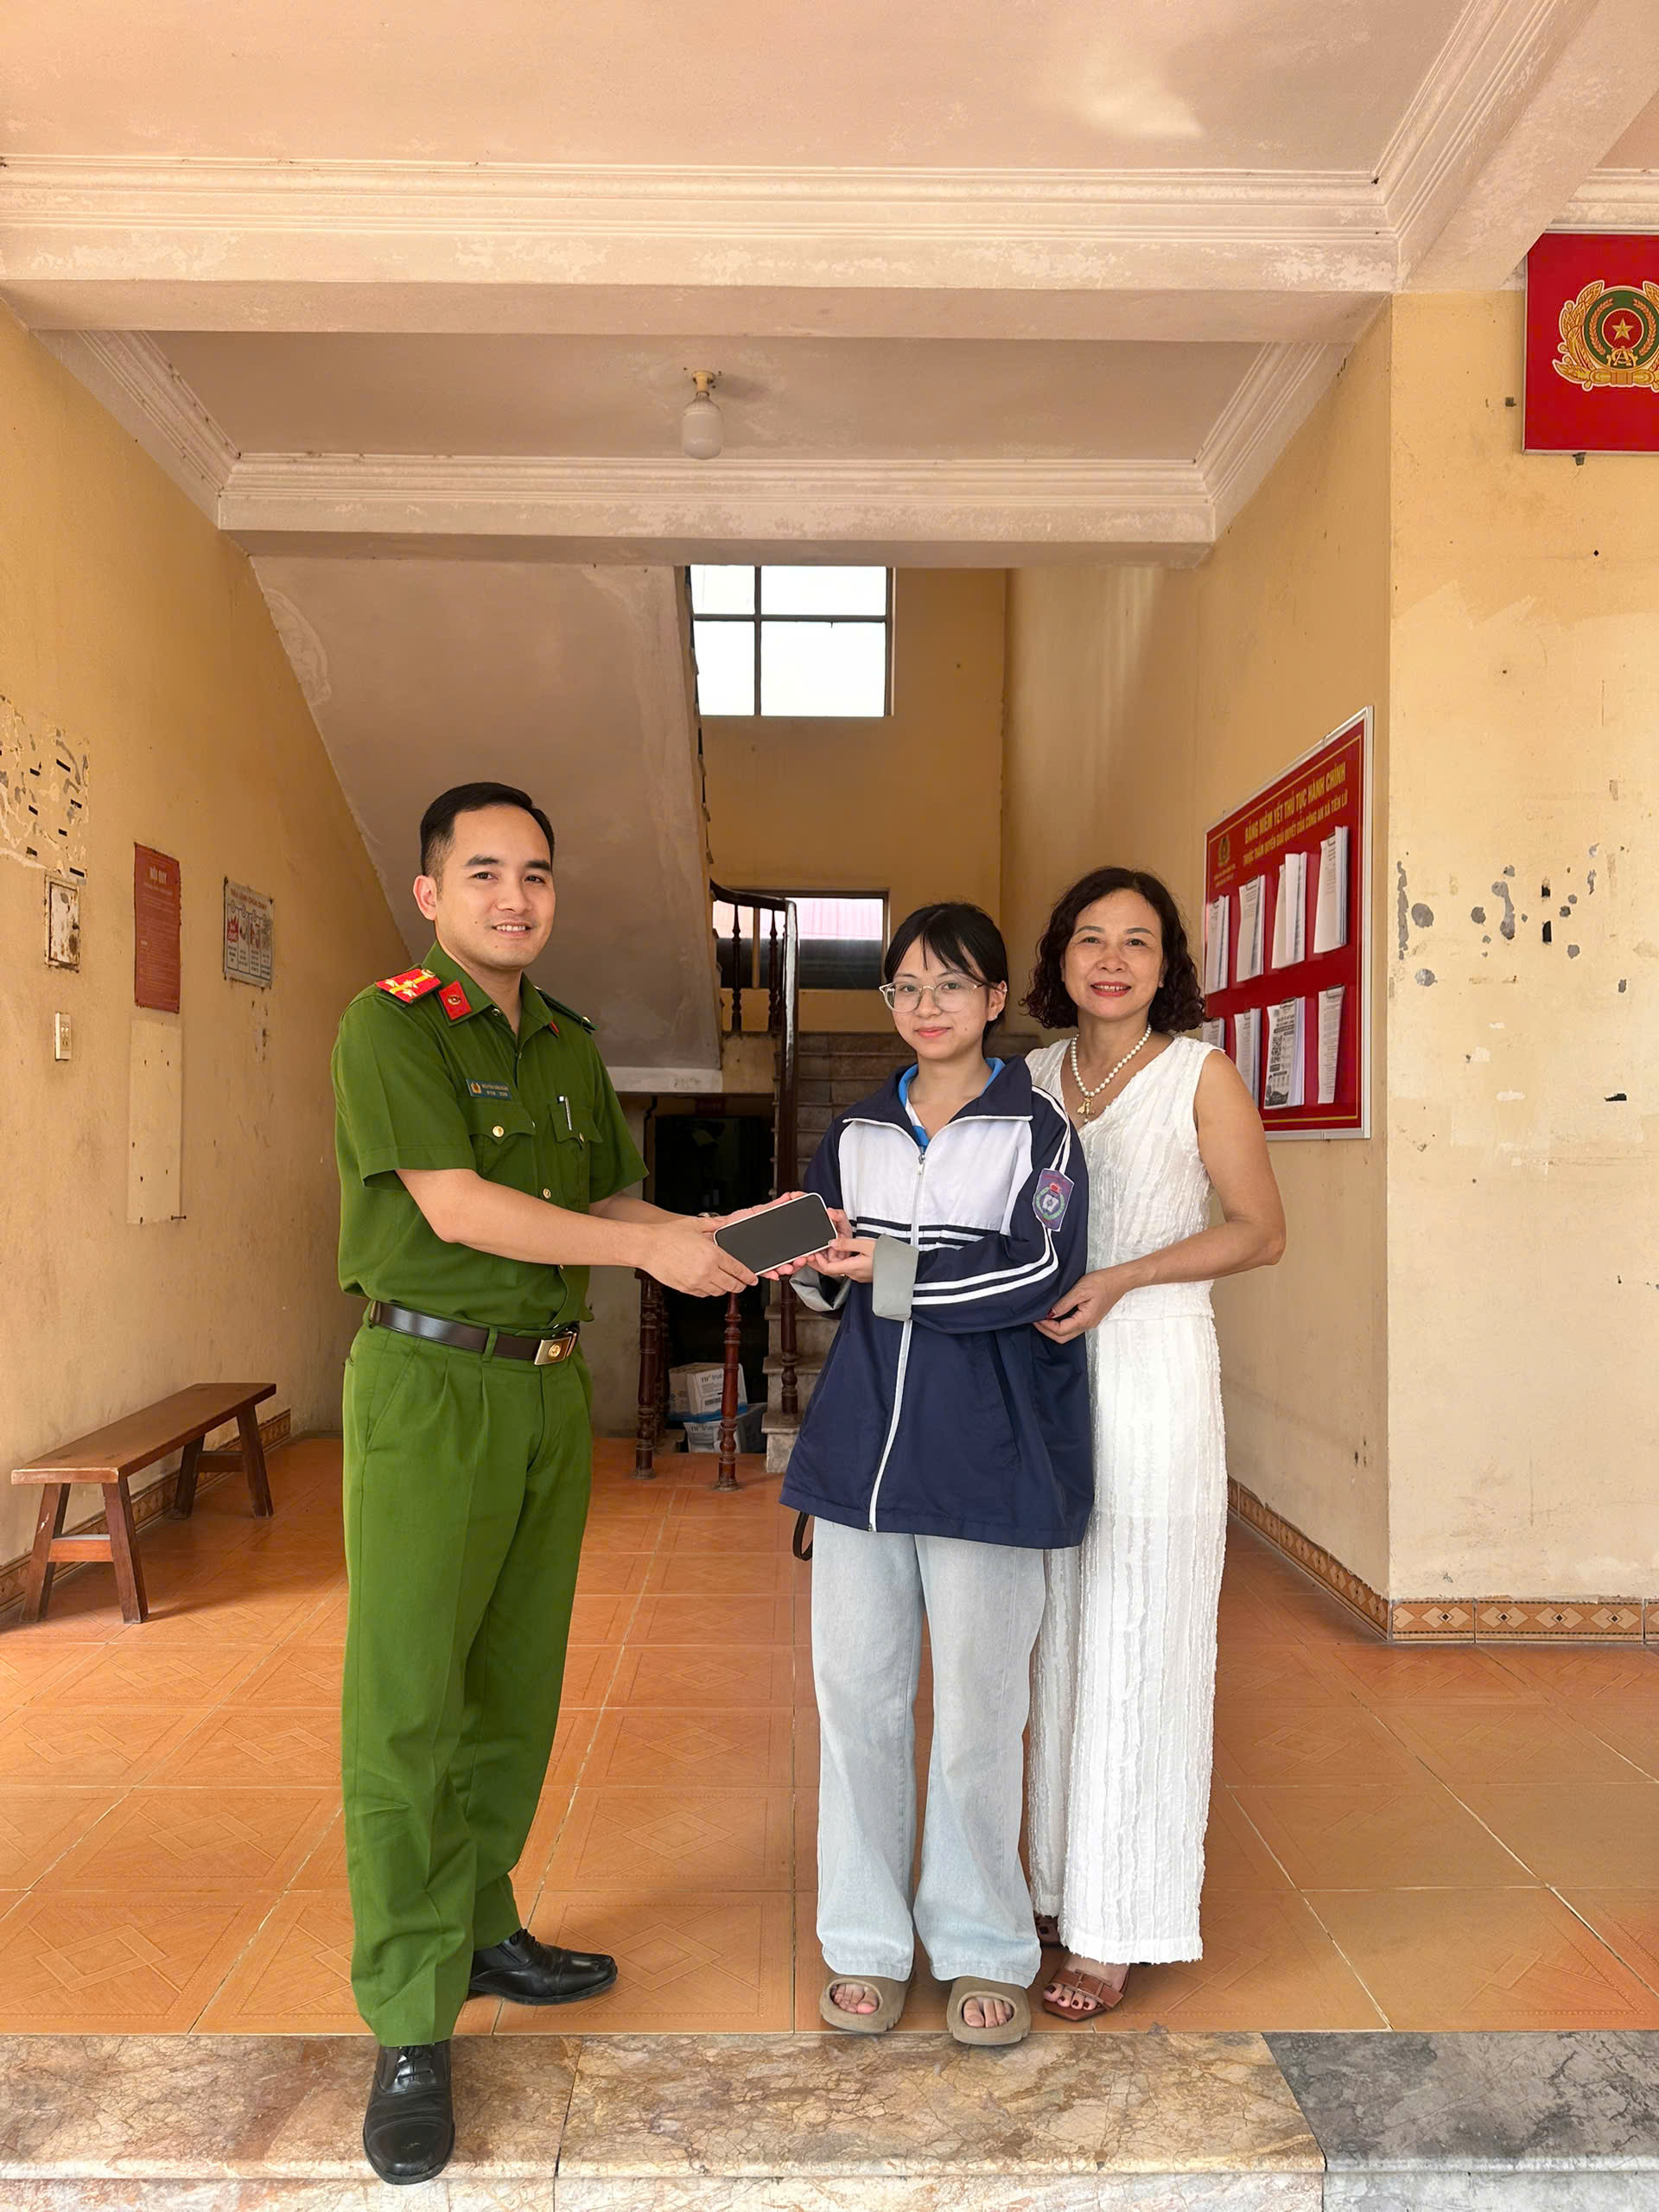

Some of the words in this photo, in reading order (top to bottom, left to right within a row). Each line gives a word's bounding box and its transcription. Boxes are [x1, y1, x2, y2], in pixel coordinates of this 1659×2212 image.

[1274, 801, 1283, 826] YẾT
[1284, 791, 1295, 819] THỦ
[1296, 788, 1307, 814] TỤC
[1308, 776, 1325, 804] HÀNH
[1326, 762, 1345, 791] CHÍNH
